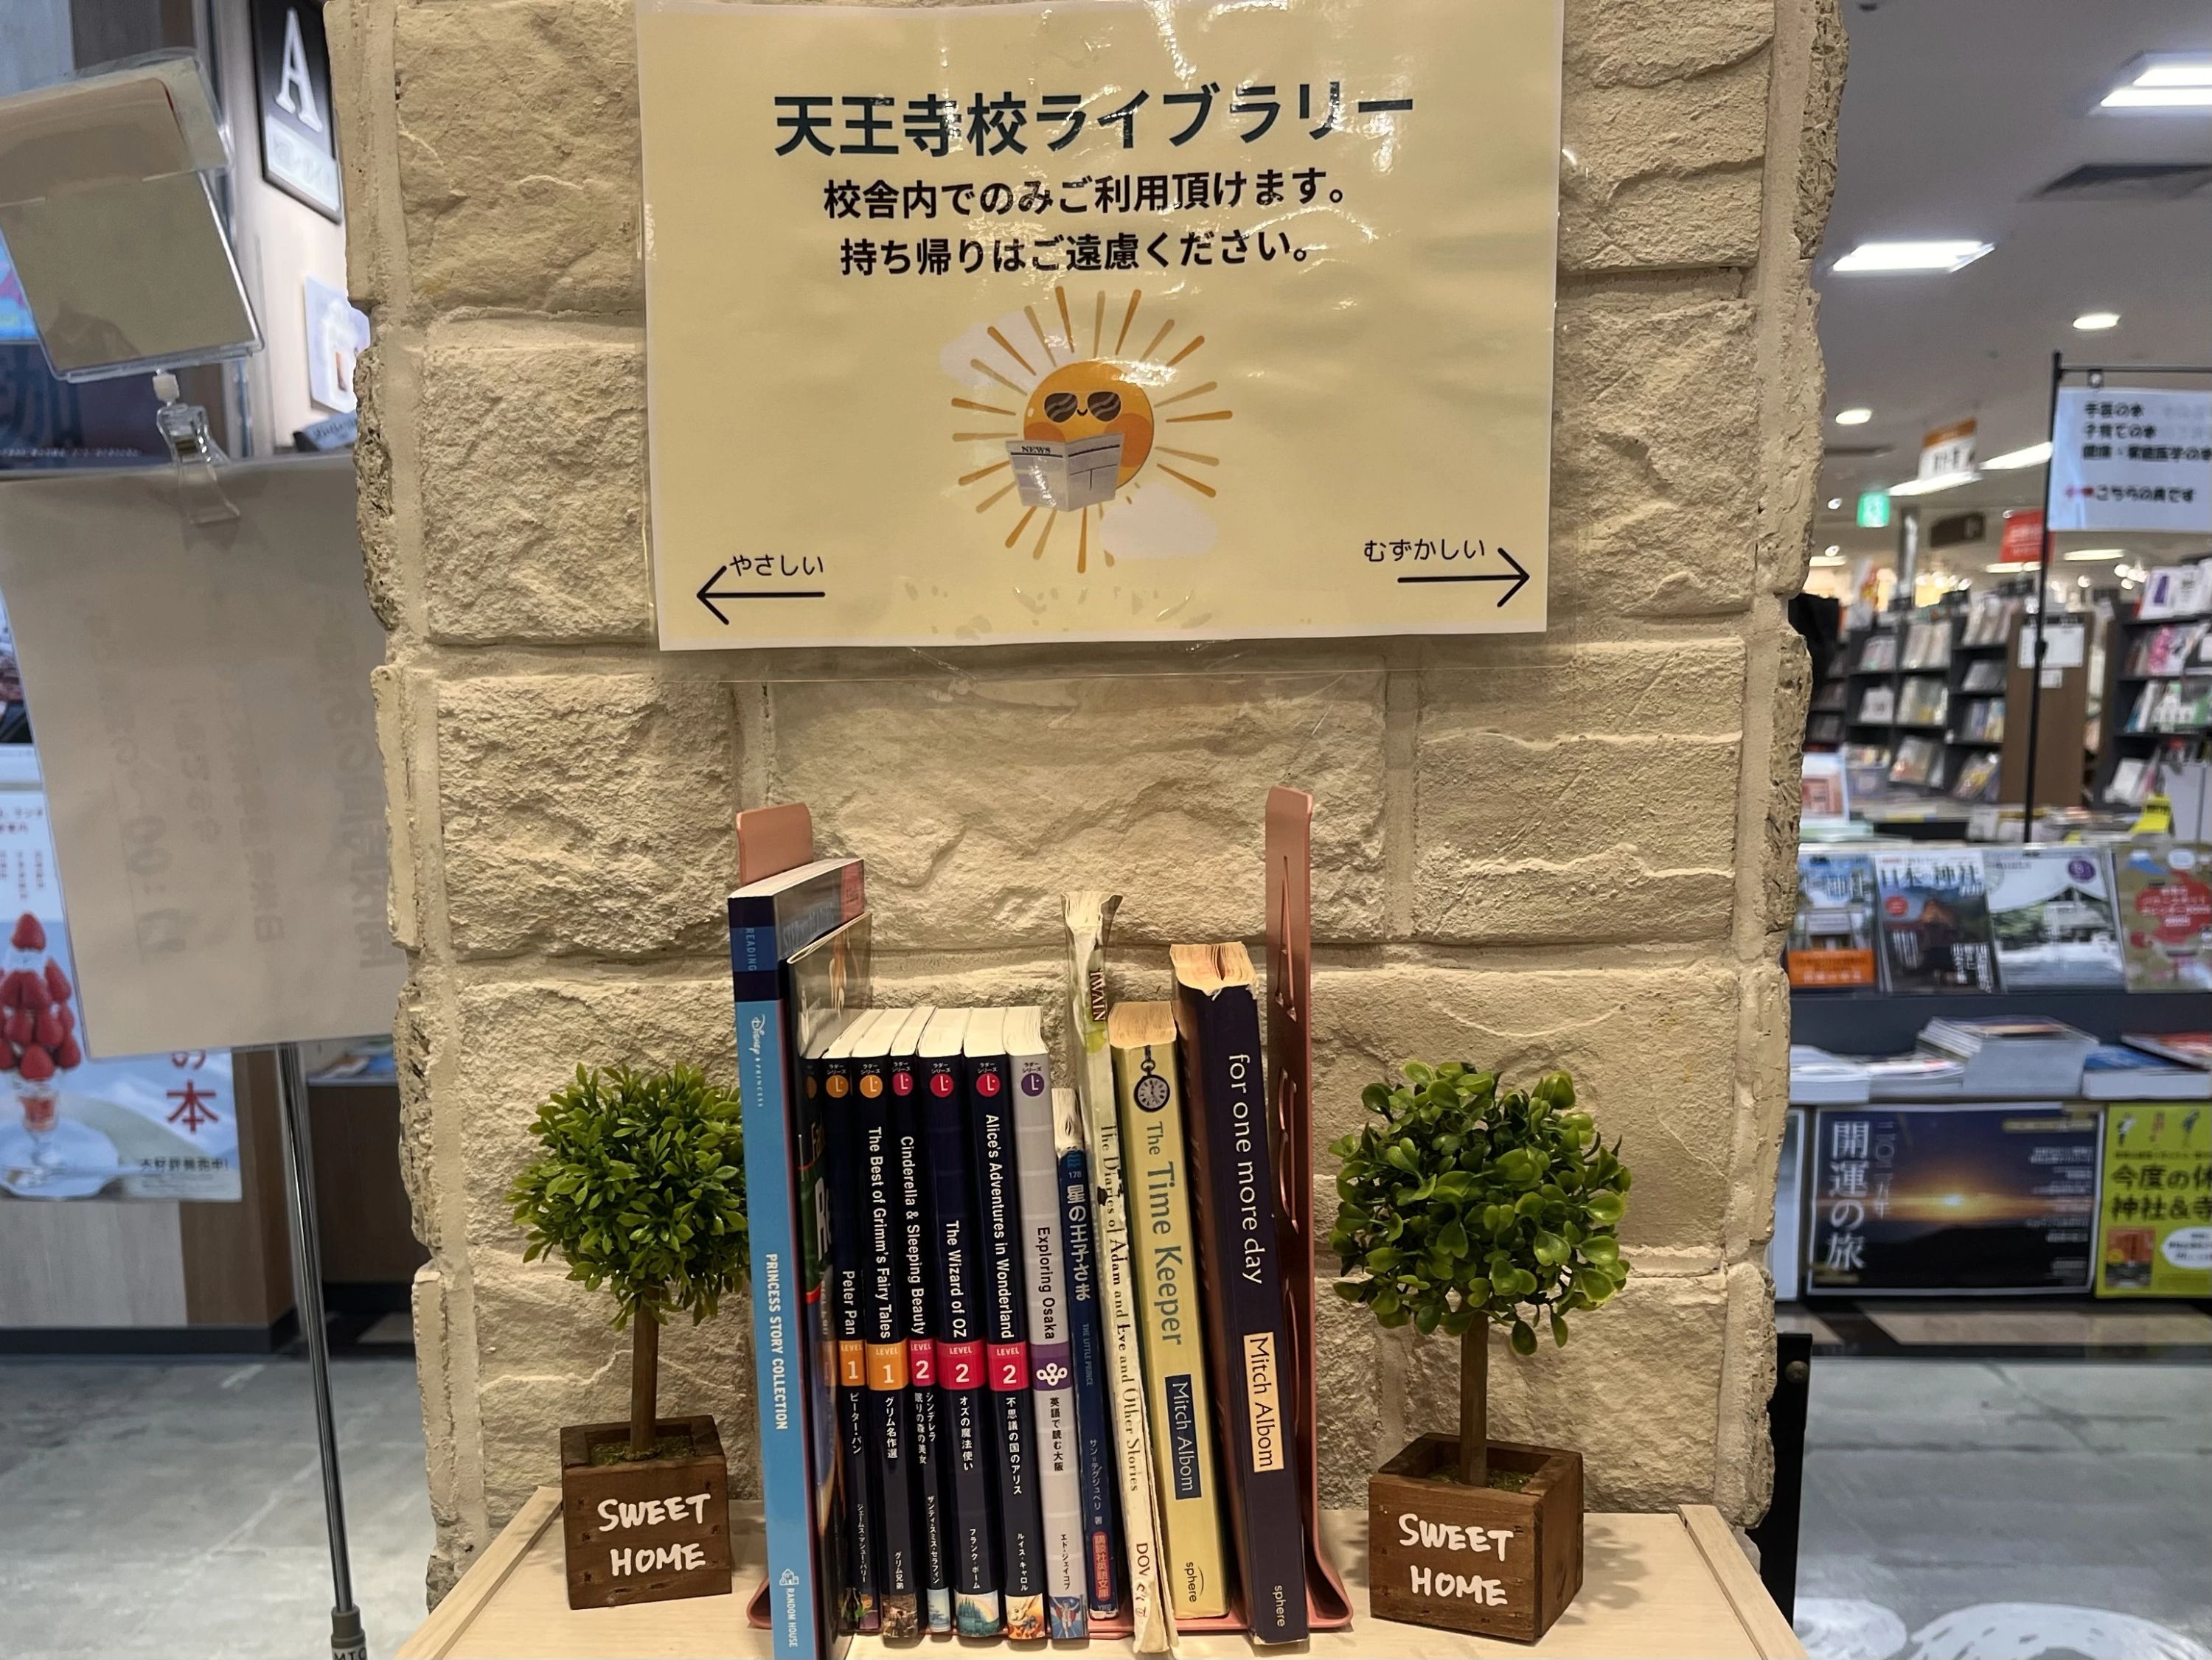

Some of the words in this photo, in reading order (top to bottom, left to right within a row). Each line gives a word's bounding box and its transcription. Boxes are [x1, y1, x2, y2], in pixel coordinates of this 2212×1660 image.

[773, 78, 1415, 157] 天王寺校ライブラリー
[823, 167, 1346, 221] 校舎内でのみご利用頂けます。
[839, 229, 1308, 277] 持ち帰りはご遠慮ください。
[1020, 444, 1052, 454] NEWS
[730, 553, 824, 578] やさしい
[1363, 537, 1486, 563] むずかしい
[745, 927, 757, 972] READING
[1089, 967, 1106, 1022] TWAIN
[1228, 1054, 1251, 1094] for
[869, 1127, 882, 1152] The
[986, 1115, 1000, 1158] Alice's
[1100, 1123, 1117, 1151] The
[1147, 1122, 1165, 1155] The
[1233, 1102, 1251, 1154] one
[870, 1157, 884, 1187] Best
[901, 1136, 918, 1206] Cinderella
[1102, 1156, 1121, 1215] Diaries
[872, 1190, 886, 1204] of
[907, 1211, 919, 1219] &
[989, 1161, 1004, 1238] Adventures
[1147, 1162, 1175, 1235] Time
[1238, 1162, 1258, 1231] more
[1826, 1120, 1869, 1271] 開運の旅
[873, 1208, 888, 1263] Grimm's
[945, 1221, 959, 1246] The
[1067, 1184, 1091, 1301] 星の王子さま
[1107, 1219, 1126, 1233] of
[908, 1224, 922, 1283] Sleeping
[995, 1241, 1006, 1255] in
[1036, 1227, 1051, 1293] Exploring
[1110, 1238, 1128, 1286] Adam
[1242, 1238, 1267, 1284] day
[765, 1253, 781, 1312] PRINCESS
[842, 1271, 855, 1306] Peter
[875, 1267, 890, 1301] Fairy
[948, 1247, 964, 1297] Wizard
[911, 1288, 925, 1335] Beauty
[952, 1300, 965, 1314] of
[996, 1259, 1015, 1339] Wonderland
[1114, 1290, 1130, 1318] and
[1152, 1246, 1183, 1345] Keeper
[768, 1316, 784, 1354] STORY
[845, 1310, 857, 1335] Pan
[879, 1304, 893, 1339] Tales
[1043, 1298, 1056, 1339] Osaka
[1117, 1323, 1131, 1352] Eve
[841, 1344, 863, 1352] LEVEL
[910, 1343, 932, 1352] LEVEL
[949, 1347, 973, 1355] LEVEL
[996, 1347, 1020, 1356] LEVEL
[1250, 1336, 1269, 1395] Mitch
[848, 1361, 858, 1380] 1
[883, 1364, 894, 1384] 1
[916, 1361, 931, 1379] 2
[956, 1364, 970, 1383] 2
[1003, 1364, 1018, 1384] 2
[1119, 1356, 1135, 1384] and
[771, 1358, 788, 1430] COLLECTION
[1122, 1388, 1141, 1434] Other
[1172, 1381, 1192, 1429] Mitch
[849, 1392, 864, 1455] ピーター・パン
[885, 1395, 898, 1460] グリム名作選
[914, 1392, 928, 1465] 眠りの森の美女
[925, 1392, 936, 1443] シンデレラ
[959, 1396, 974, 1471] オズの魔法使い
[1048, 1397, 1064, 1472] 英語で読む大阪
[1254, 1402, 1274, 1468] Albom
[1006, 1397, 1022, 1496] 不思議の国のアリス
[1127, 1440, 1141, 1492] Stories
[1177, 1435, 1195, 1492] Albom
[597, 1493, 711, 1532] SWEET
[970, 1528, 981, 1590] フランク・ボーム
[1398, 1513, 1514, 1562] SWEET
[611, 1543, 706, 1577] HOME
[894, 1551, 905, 1590] グリム兄弟
[1017, 1533, 1029, 1591] ルイス・キャロル
[1186, 1561, 1198, 1603] sphere
[1410, 1565, 1508, 1606] HOME
[785, 1588, 796, 1620] RANDOM
[1274, 1585, 1287, 1628] sphere
[787, 1623, 799, 1647] HOUSE
